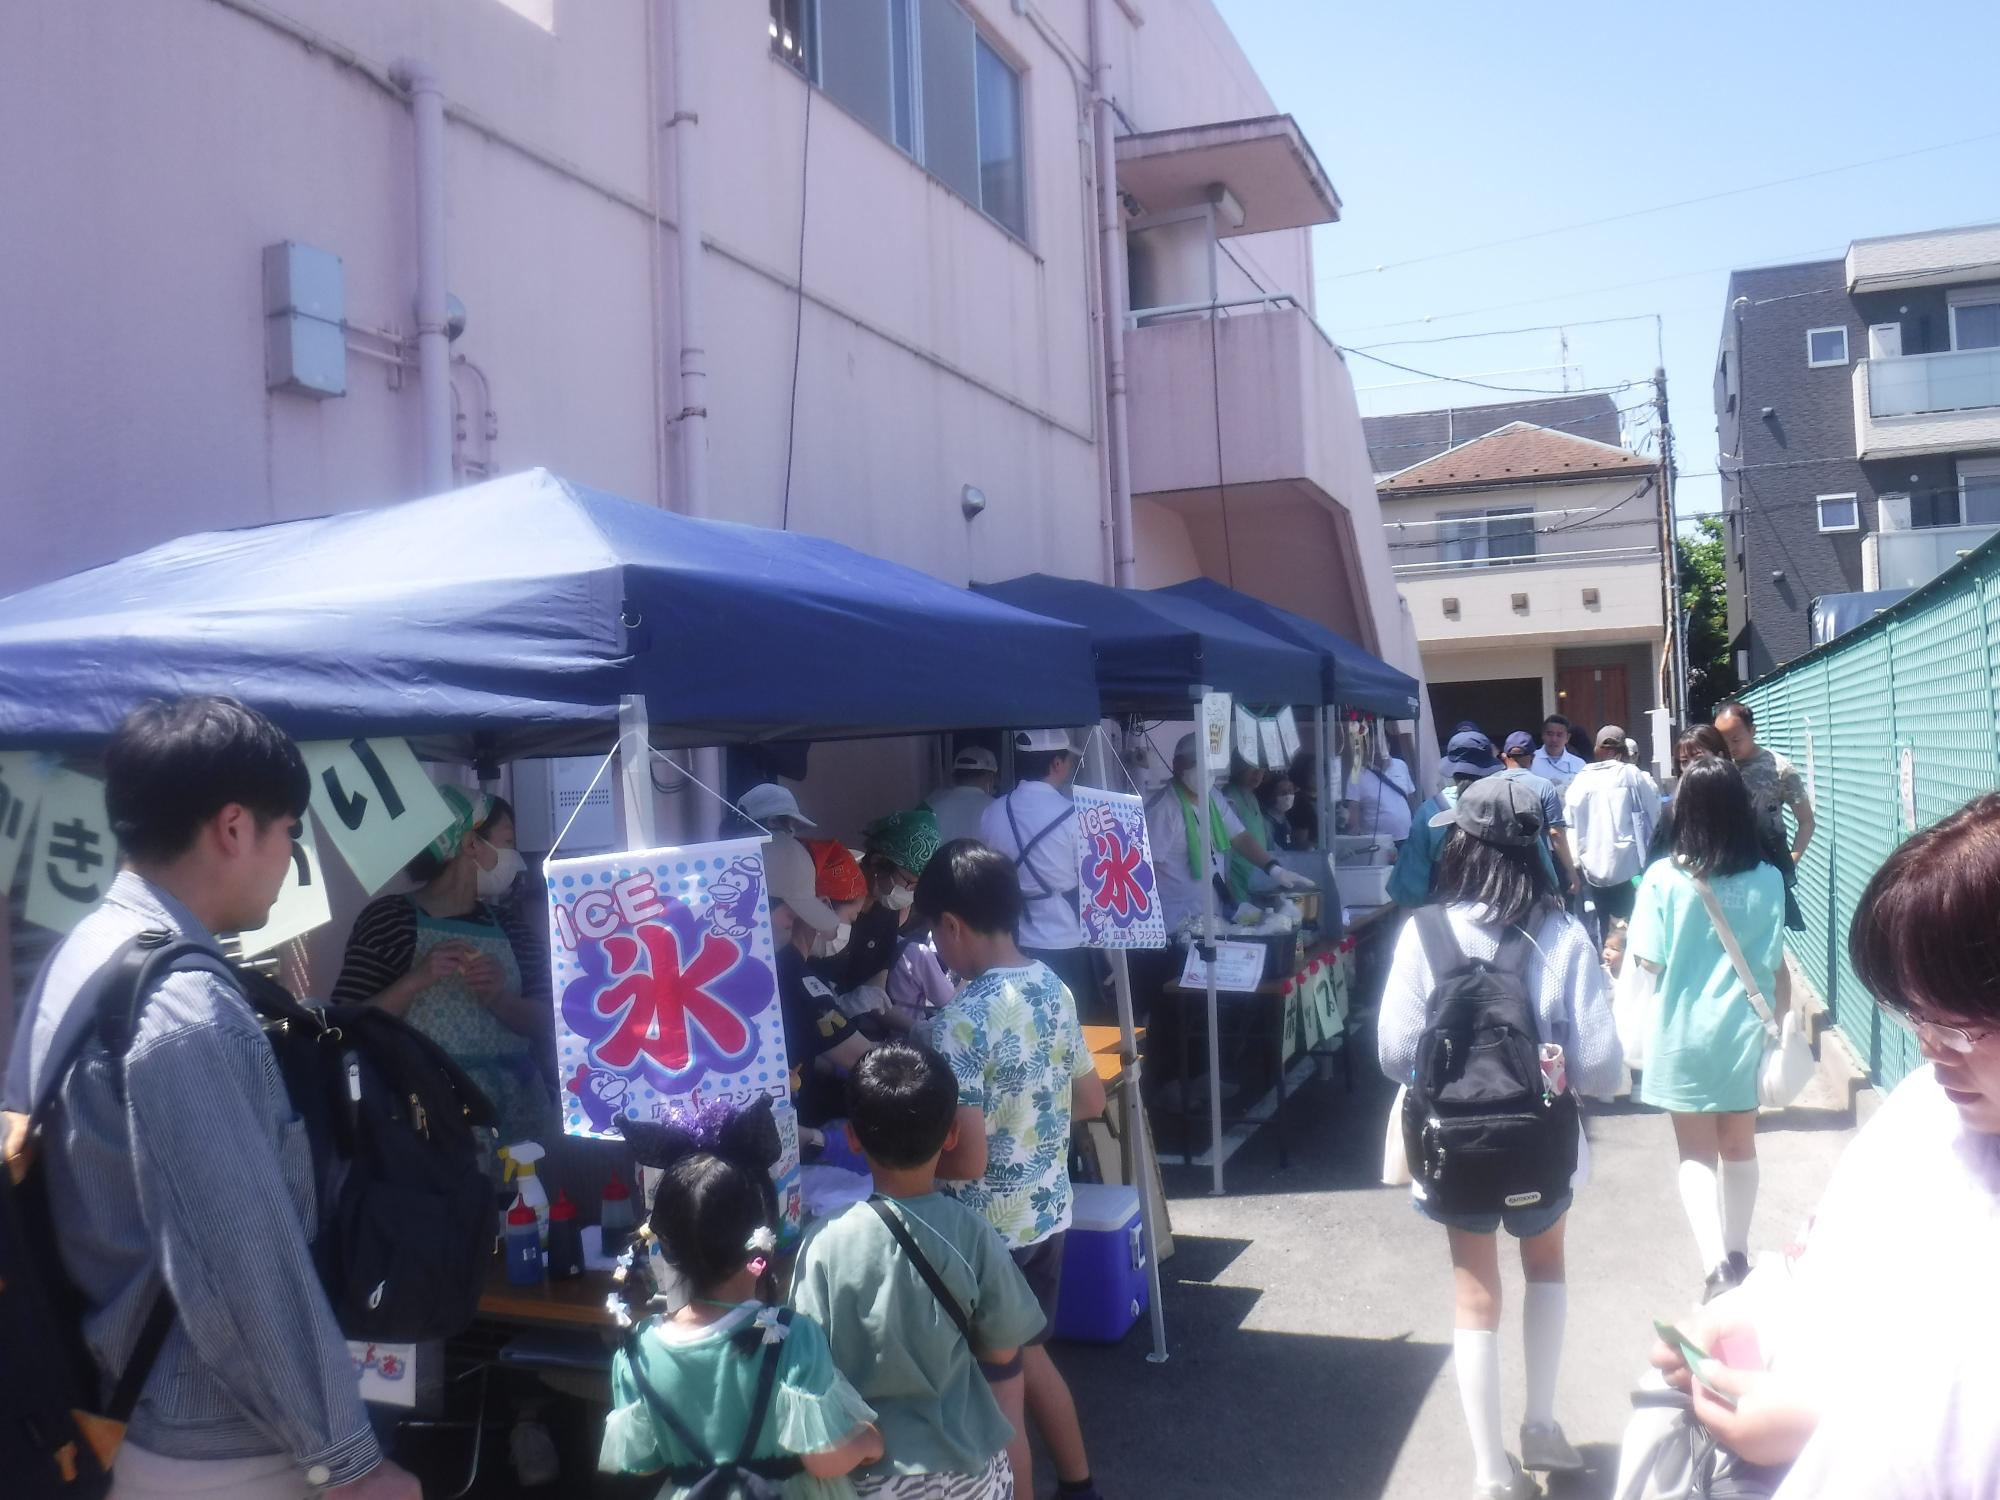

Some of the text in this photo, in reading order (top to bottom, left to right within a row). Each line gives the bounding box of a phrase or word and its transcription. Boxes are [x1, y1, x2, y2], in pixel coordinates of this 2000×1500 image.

[46, 816, 103, 904] き
[1078, 803, 1115, 838] ICE
[554, 872, 664, 951] ICE
[1094, 832, 1148, 916] 氷
[595, 924, 748, 1071] 氷
